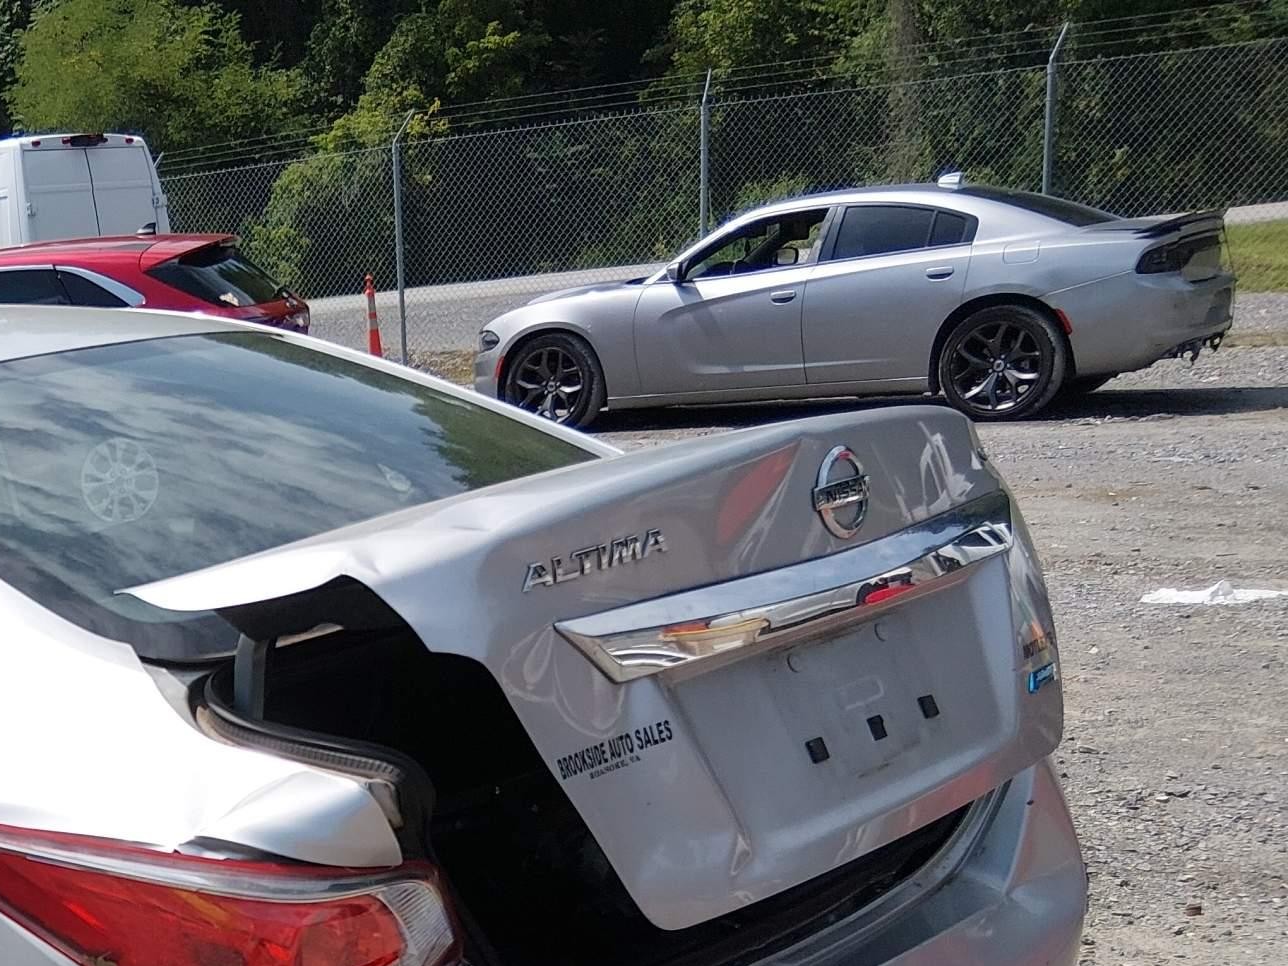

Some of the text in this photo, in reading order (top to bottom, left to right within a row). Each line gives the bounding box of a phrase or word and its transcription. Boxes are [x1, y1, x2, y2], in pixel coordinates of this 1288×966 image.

[825, 478, 871, 503] NISSAN
[521, 528, 668, 593] ALTIMA
[557, 719, 673, 780] BROOKSIDE AUTO SALES
